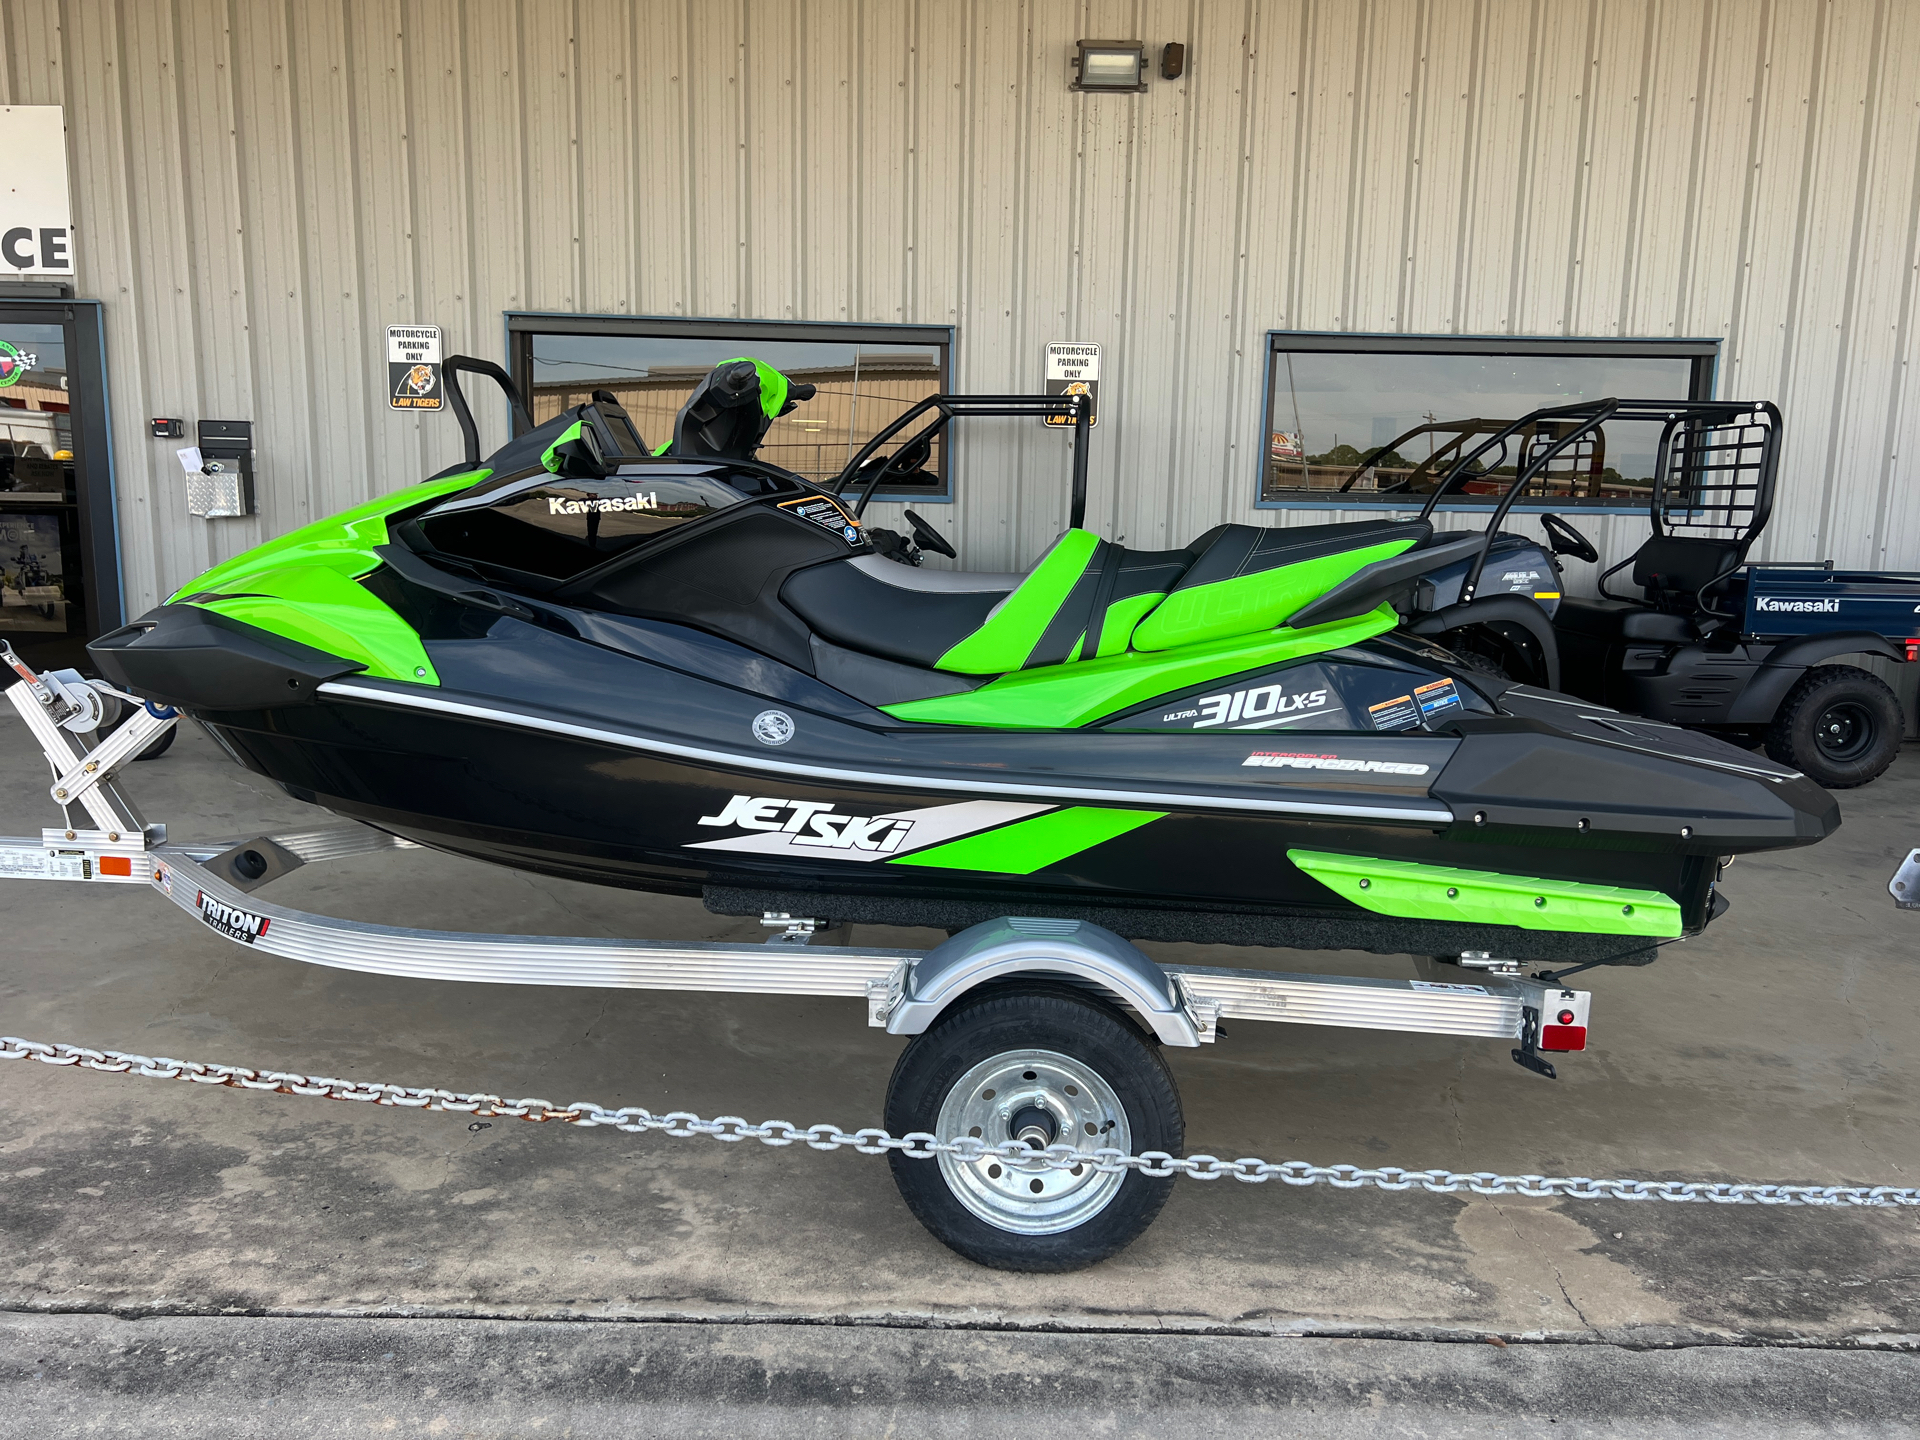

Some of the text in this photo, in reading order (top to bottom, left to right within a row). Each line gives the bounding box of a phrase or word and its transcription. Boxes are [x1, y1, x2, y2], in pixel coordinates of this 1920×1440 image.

[389, 329, 437, 339] MOTORCYCLE
[397, 341, 430, 350] PARKING
[1049, 346, 1098, 356] MOTORCYCLE
[405, 352, 423, 361] ONLY
[1057, 358, 1089, 367] PARKING
[1064, 369, 1082, 378] ONLY
[392, 397, 440, 407] LAW TIGERS
[1047, 415, 1067, 424] LAW
[548, 491, 658, 515] Kawasaki
[1755, 597, 1840, 613] Kawasaki
[1163, 709, 1198, 722] ULTRA
[1192, 684, 1282, 729] 310
[1250, 751, 1338, 759] INTERCOOLER
[1241, 755, 1430, 775] SUPERCHARGED
[697, 795, 836, 833] JET
[201, 892, 262, 935] TRITON
[209, 917, 248, 941] TRAILERS
